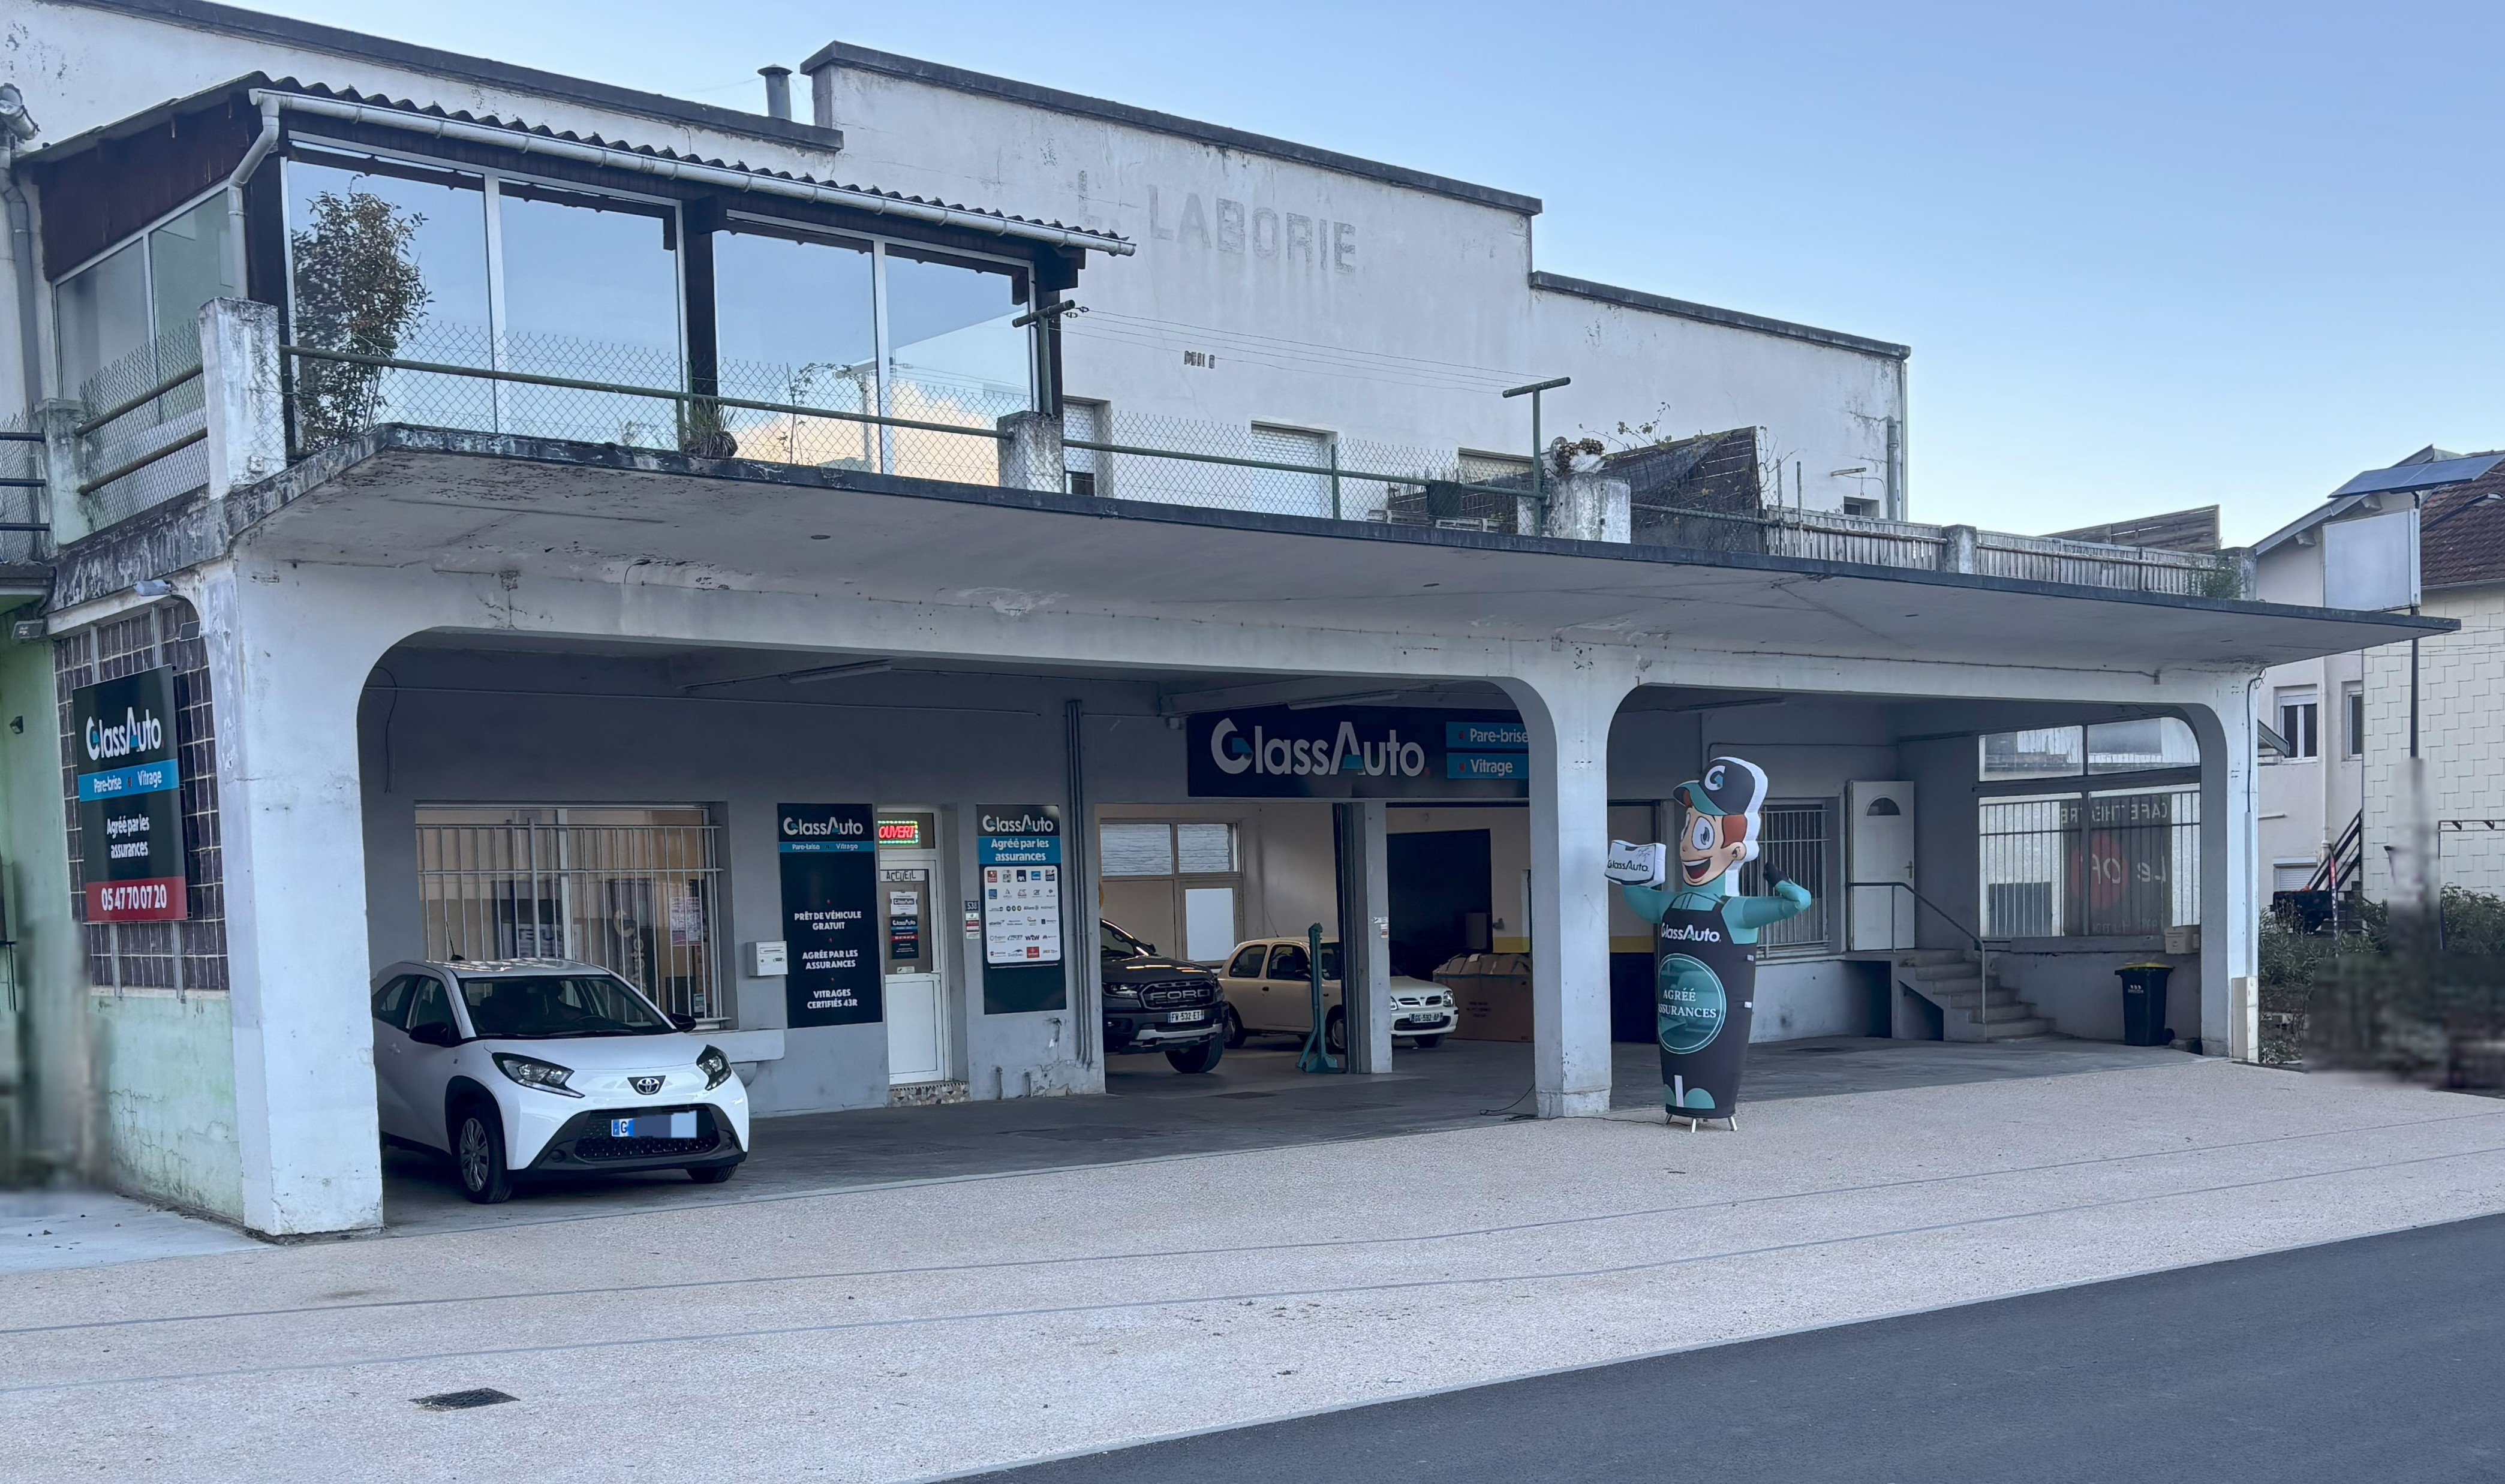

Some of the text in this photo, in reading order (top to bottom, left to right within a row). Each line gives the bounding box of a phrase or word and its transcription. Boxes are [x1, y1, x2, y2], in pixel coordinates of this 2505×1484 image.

[1148, 185, 1357, 274] LABORIE
[1470, 728, 1529, 743] Pare-brise
[1470, 758, 1513, 776] Vitrage
[94, 769, 162, 793] Pare-brise Vitrage
[107, 814, 150, 839] Agréé par les
[879, 826, 915, 838] OUVERT
[110, 841, 149, 859] assurances
[991, 838, 1049, 850] Agréé par les
[995, 852, 1046, 862] assurances
[886, 870, 916, 881] ACCUEIL
[101, 884, 167, 911] 05 47 70 07 20
[967, 901, 978, 910] 538
[795, 911, 813, 920] PRÊT
[825, 910, 862, 920] VÉHICULE
[812, 922, 845, 930] GRATUIT
[805, 960, 856, 970] ASSURANCES
[813, 989, 851, 998] VITRAGES
[1150, 989, 1210, 1001] FORD
[1663, 988, 1696, 1002] AGRÉÉ
[807, 998, 842, 1009] CERTIFIÉS
